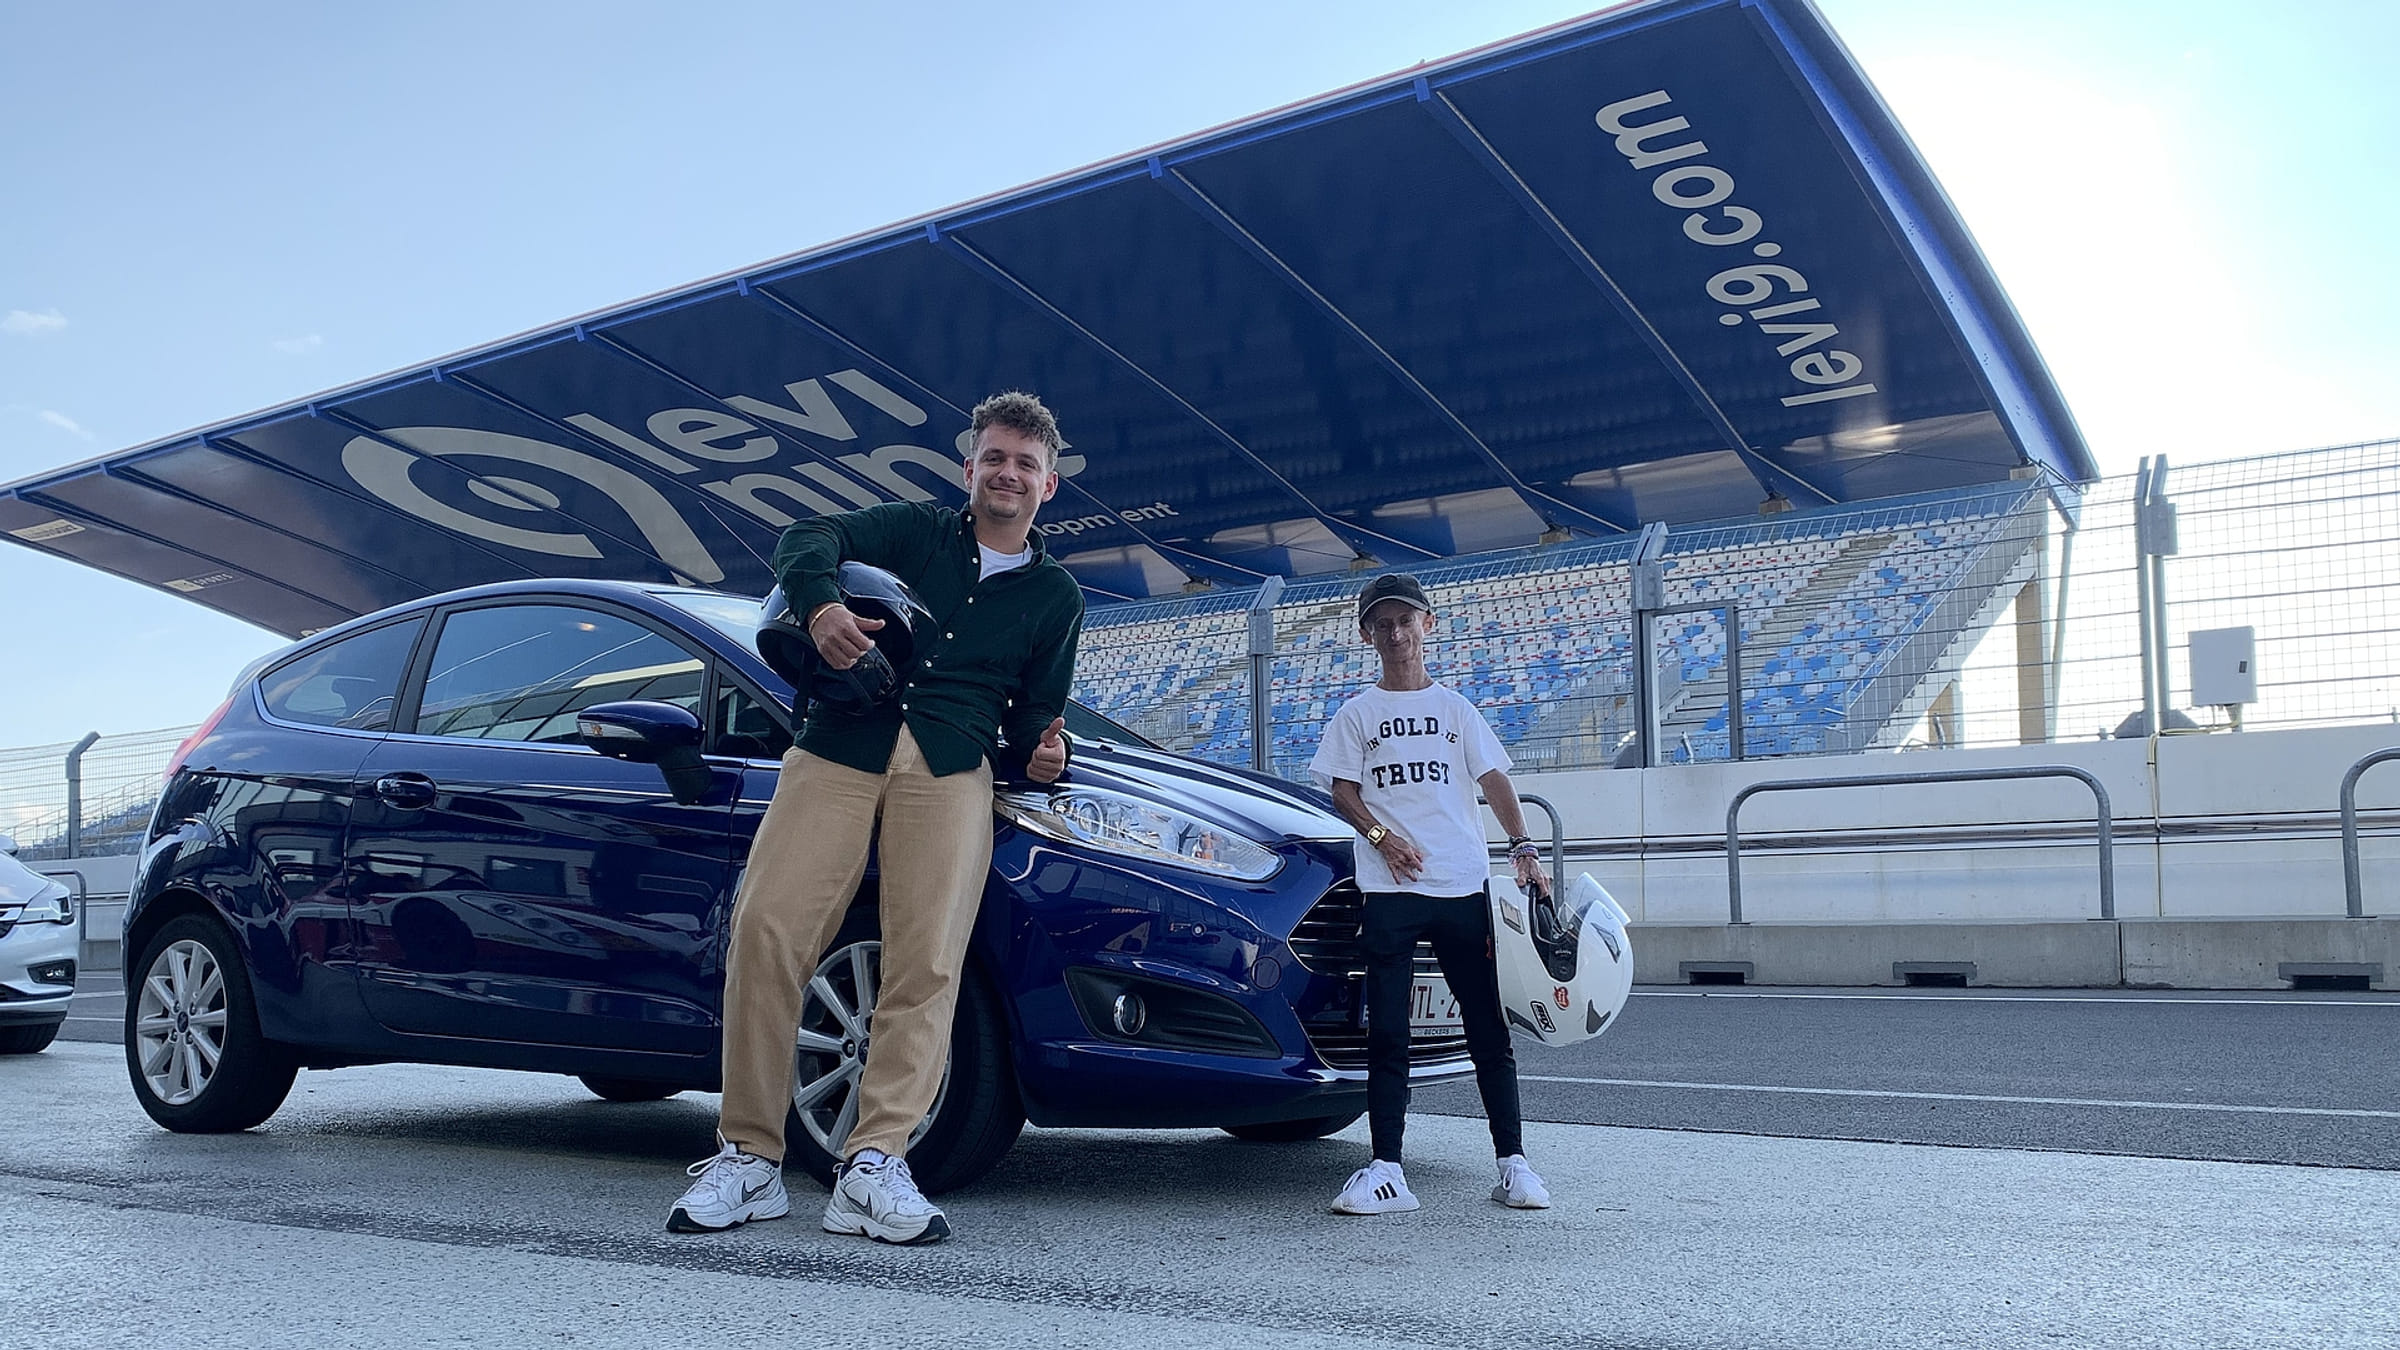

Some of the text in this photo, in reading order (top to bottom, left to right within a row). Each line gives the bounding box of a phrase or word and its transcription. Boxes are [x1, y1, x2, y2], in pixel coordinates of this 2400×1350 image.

[1595, 89, 1878, 407] levi9.com
[563, 368, 928, 475] levi
[1366, 737, 1380, 751] IN
[1379, 716, 1439, 739] GOLD
[1371, 760, 1450, 789] TRUST
